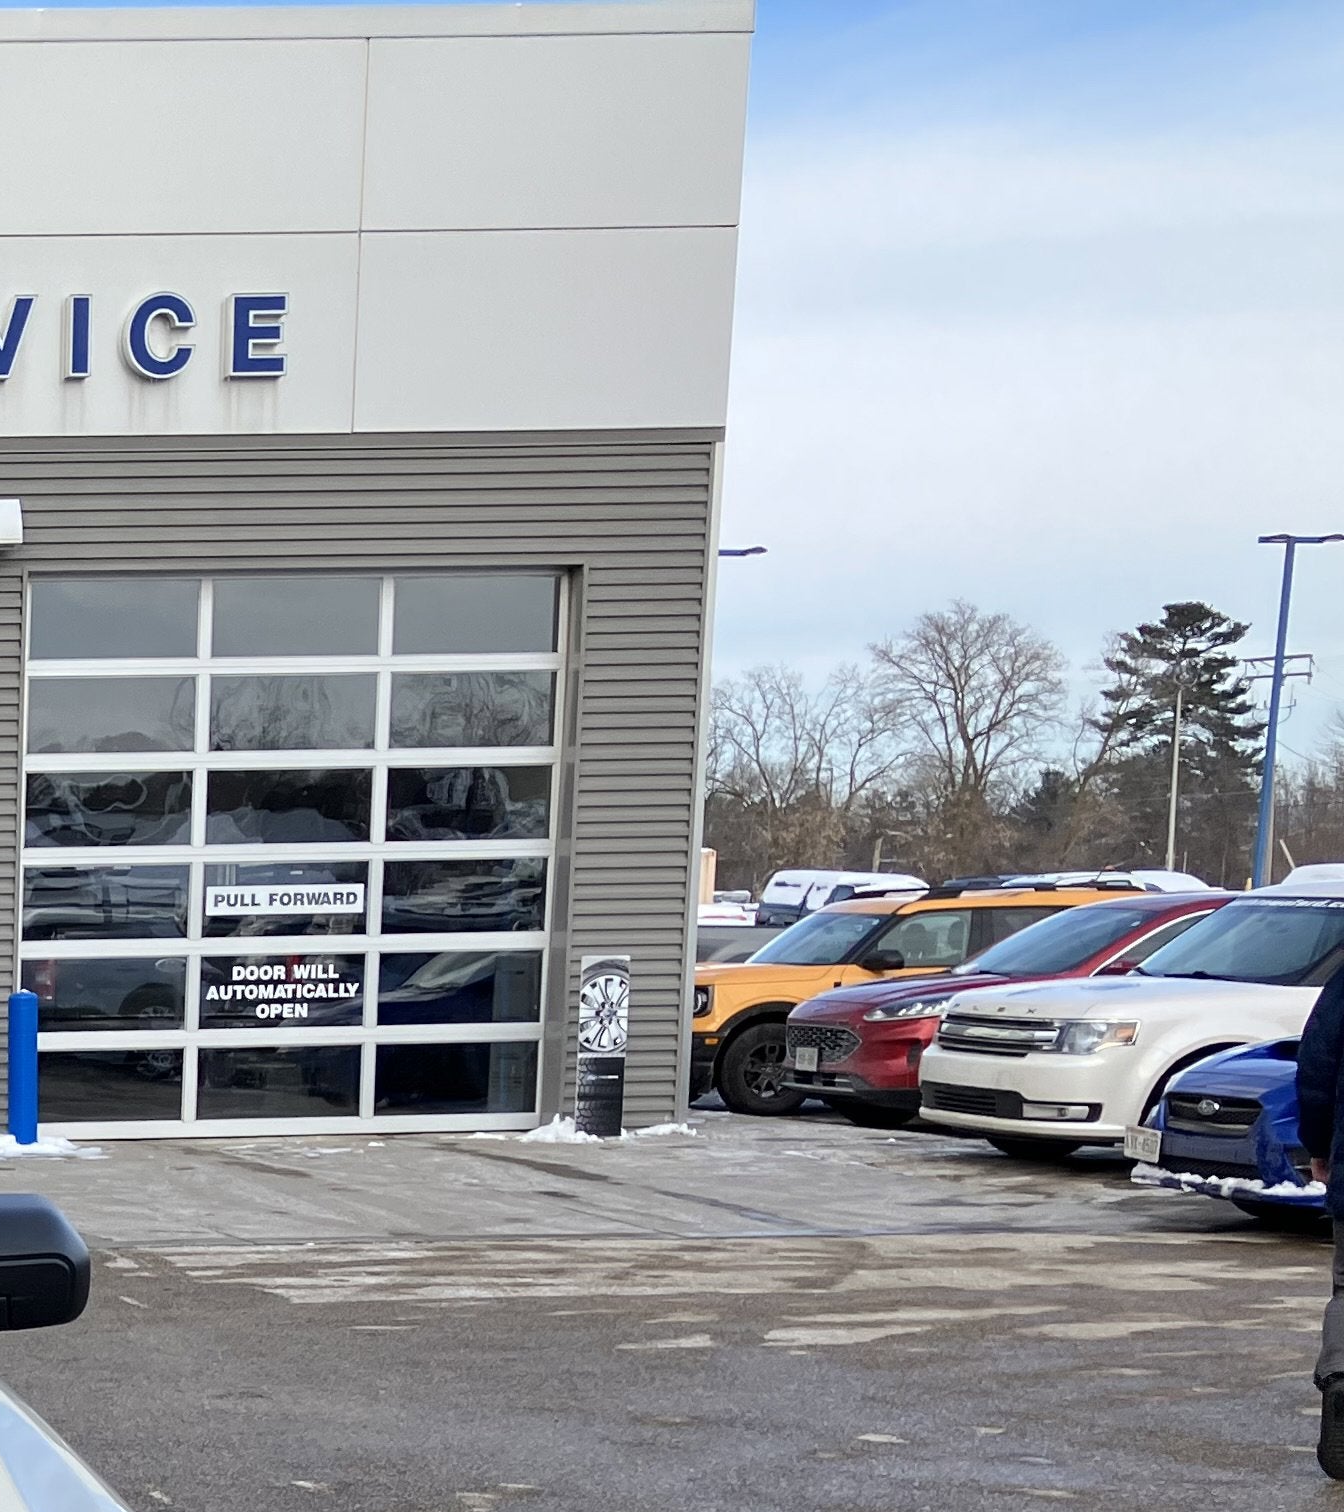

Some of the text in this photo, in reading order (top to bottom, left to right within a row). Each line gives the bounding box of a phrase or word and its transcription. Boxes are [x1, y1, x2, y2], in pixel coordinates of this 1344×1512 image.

[213, 891, 358, 908] PULL FORWARD
[232, 964, 340, 981] DOOR WILL
[206, 982, 360, 1001] AUTOMATICALLY
[255, 1003, 308, 1019] OPEN
